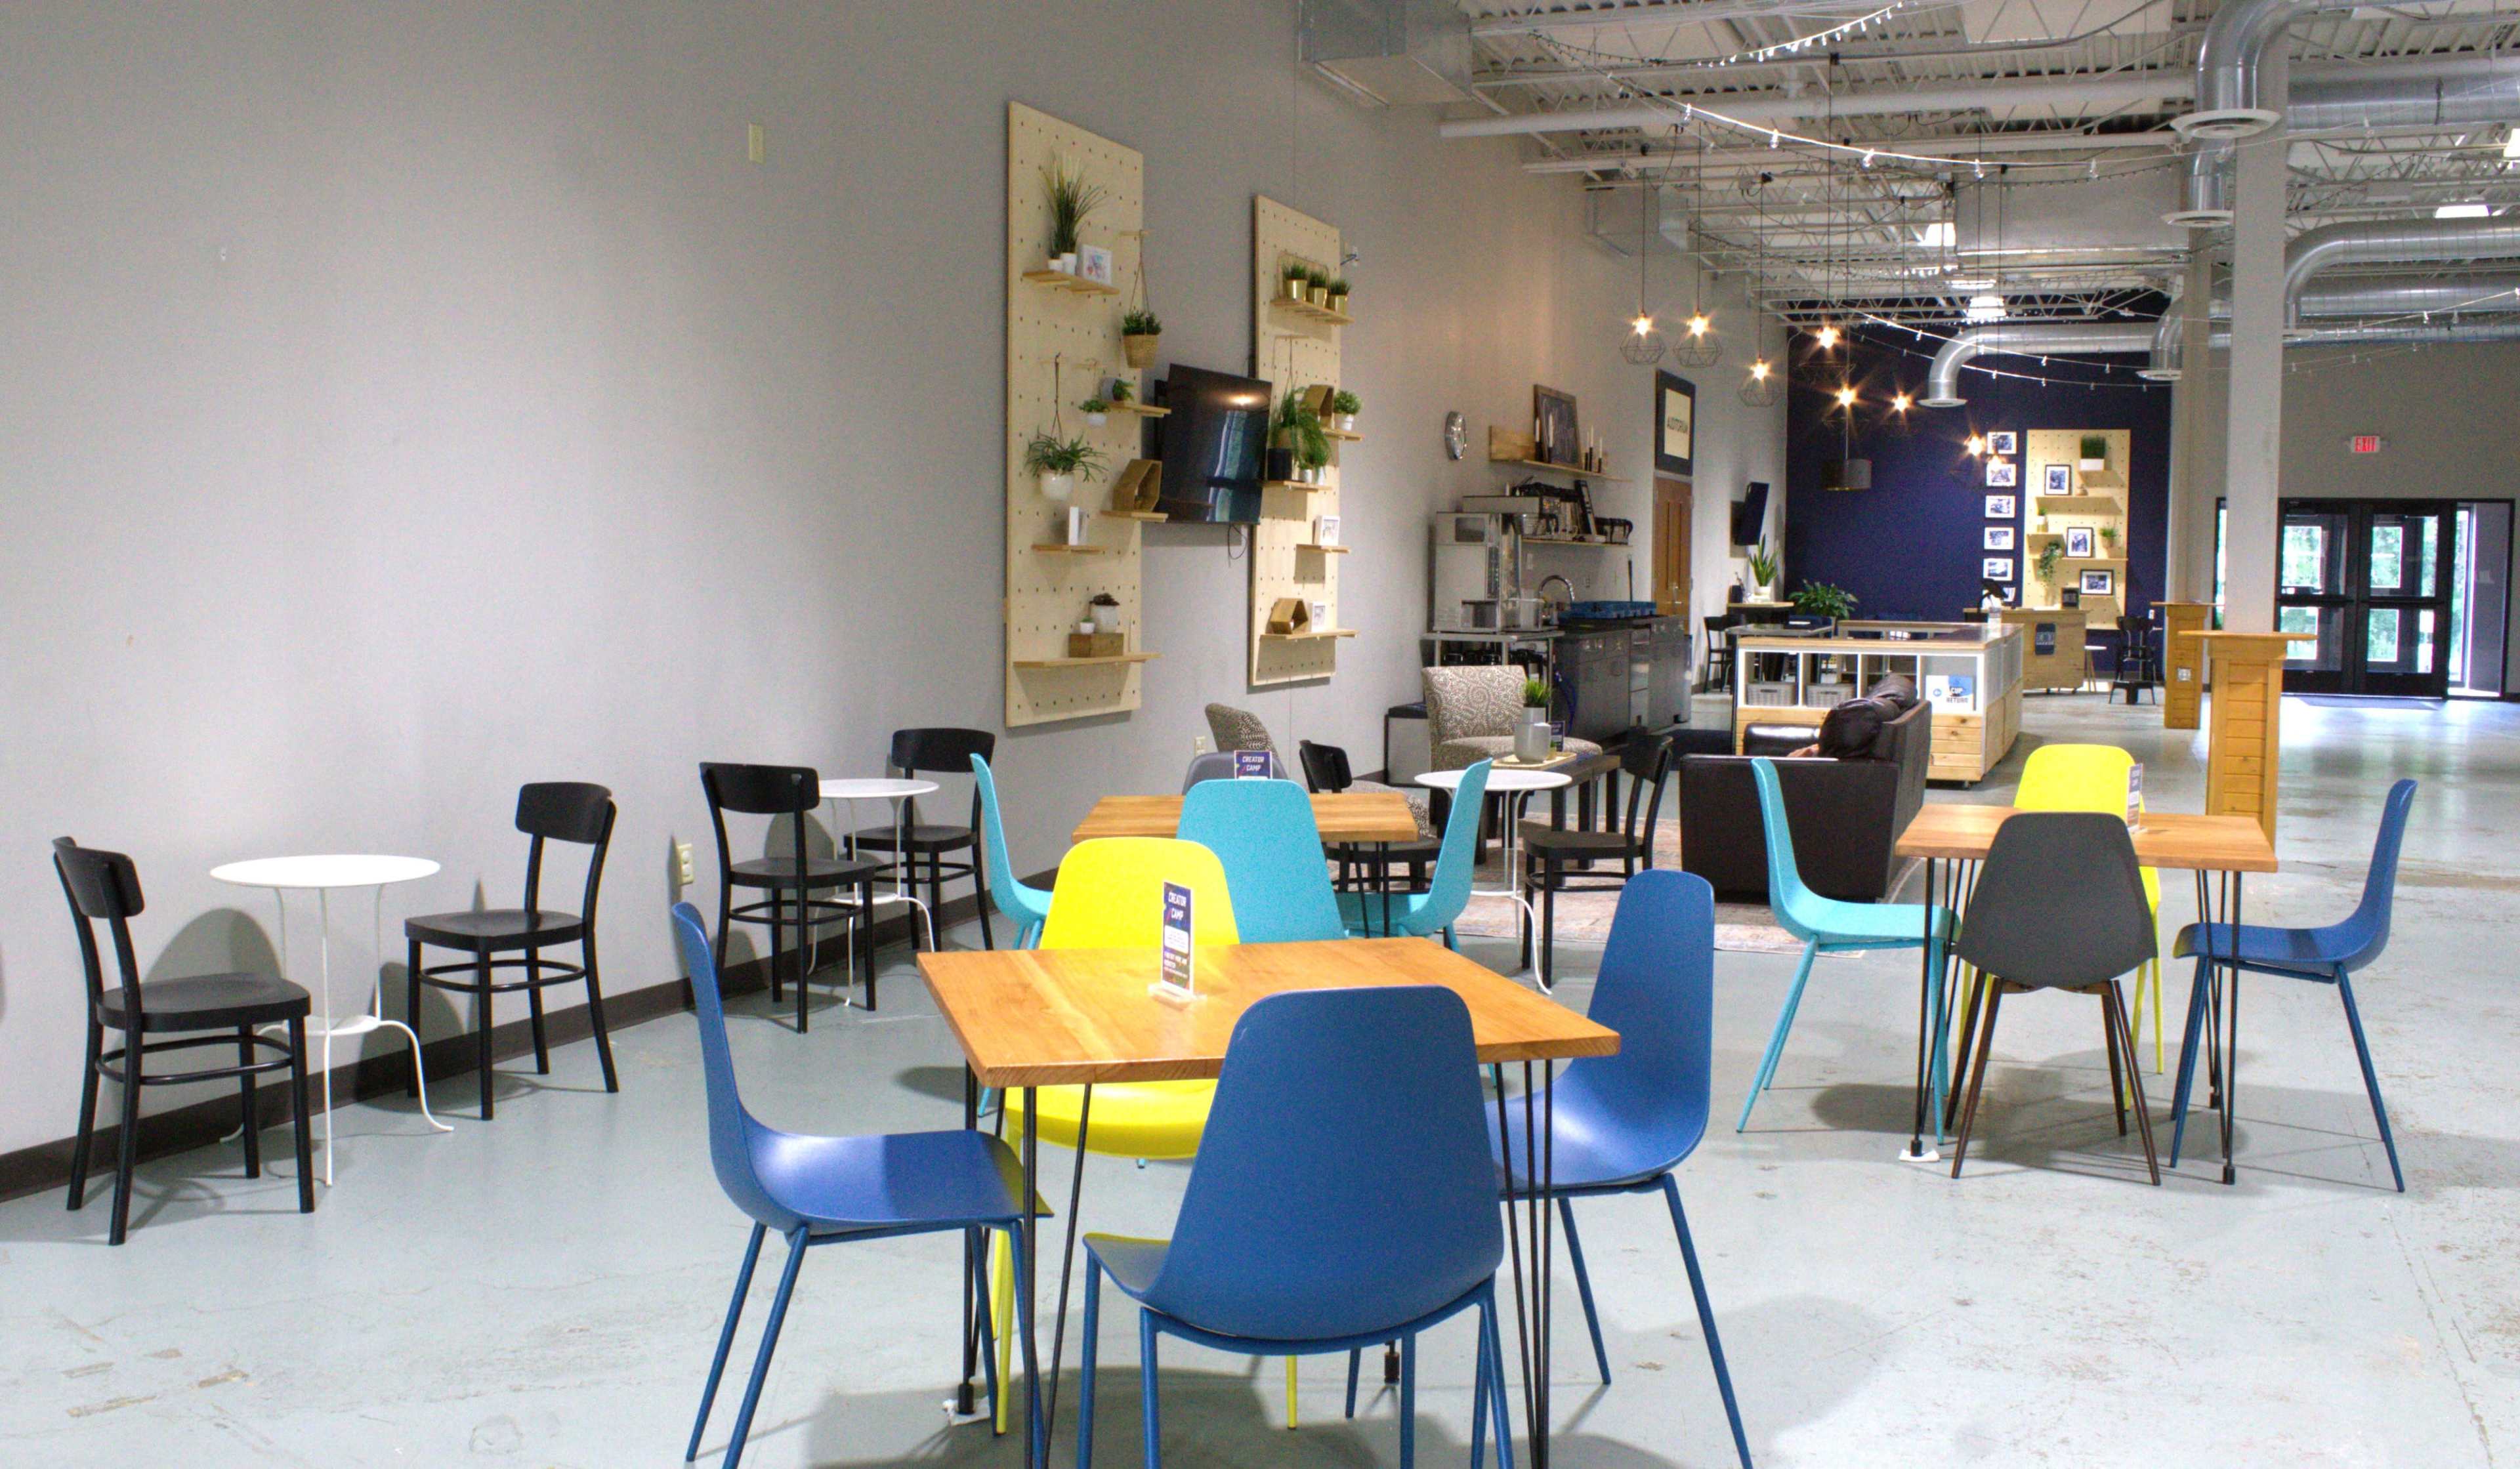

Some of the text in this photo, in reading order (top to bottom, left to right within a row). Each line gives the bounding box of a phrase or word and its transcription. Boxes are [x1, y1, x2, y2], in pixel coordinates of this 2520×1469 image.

[2355, 436, 2377, 452] EXIT
[1168, 892, 1186, 907] CREATOR
[1171, 908, 1183, 921] CAMP
